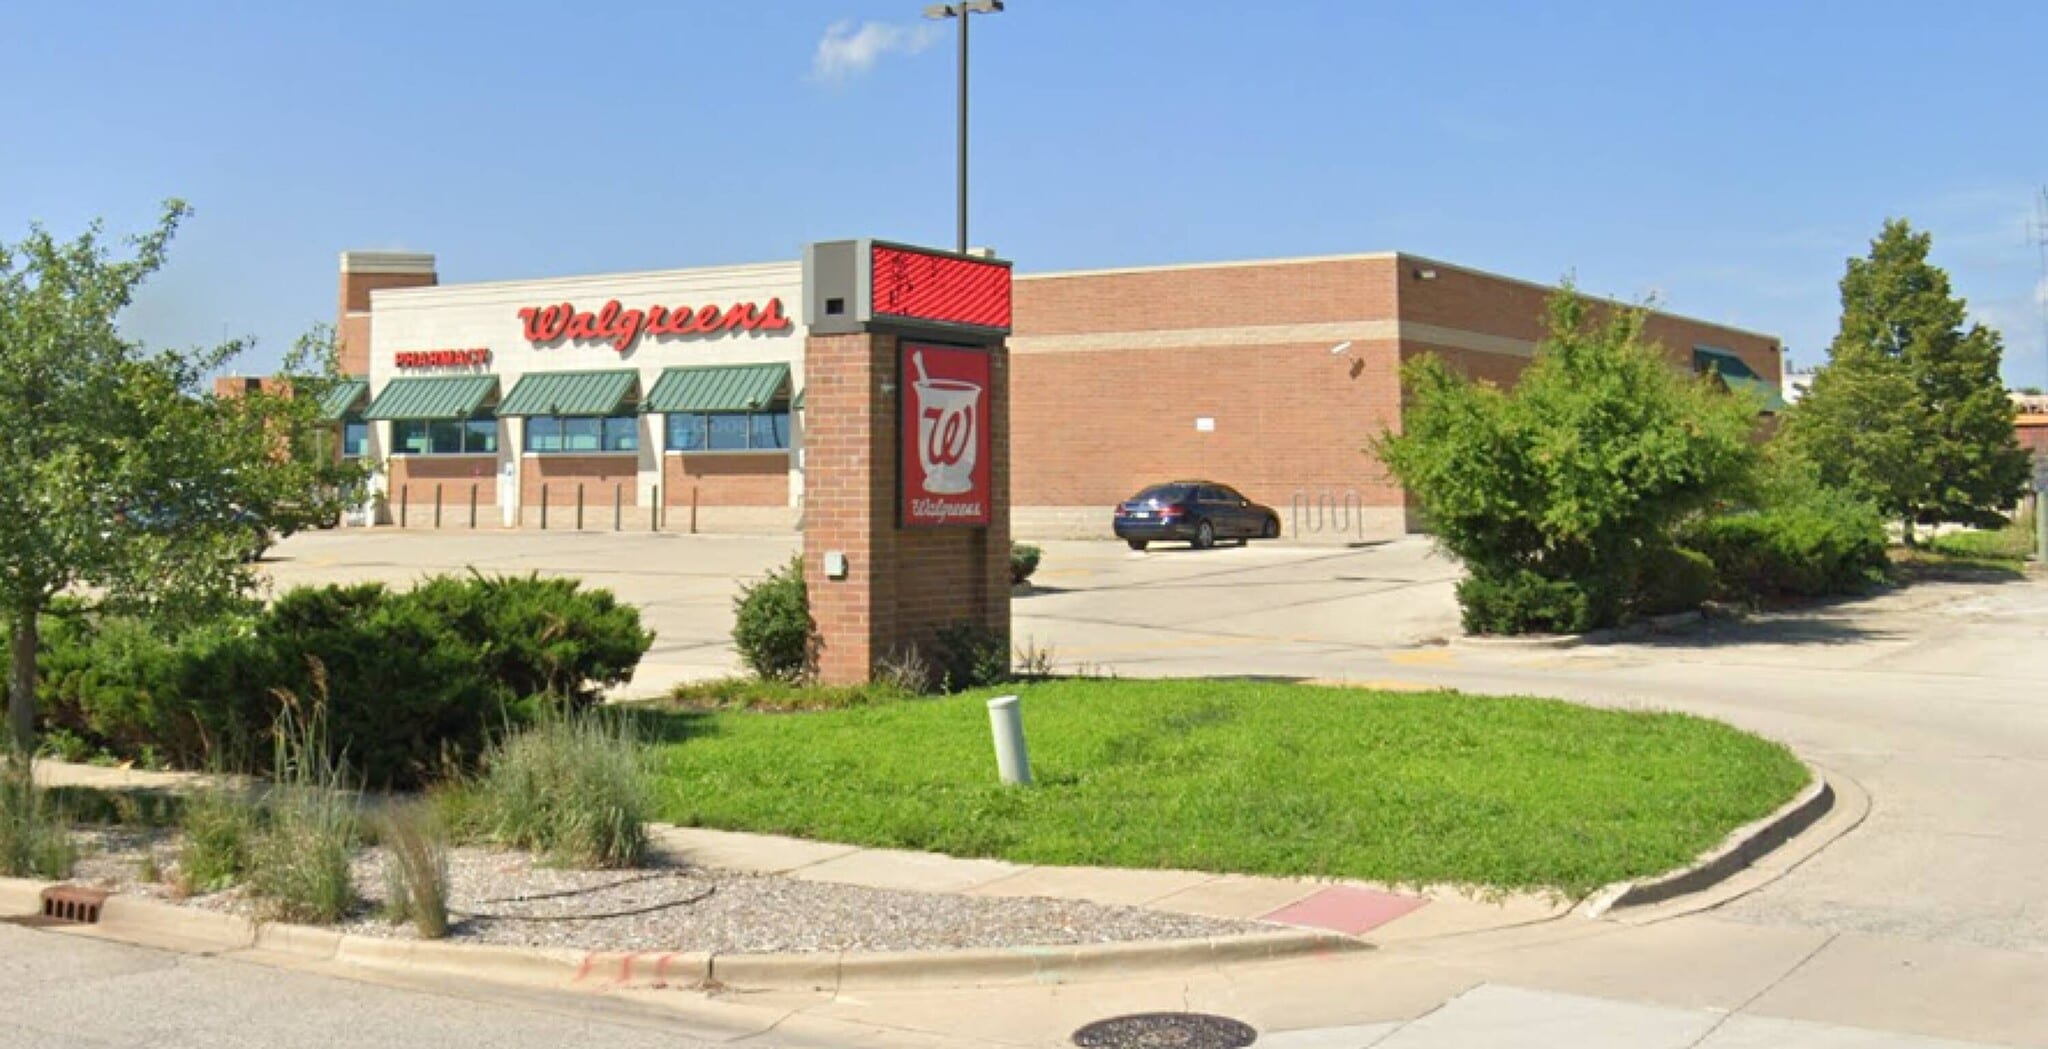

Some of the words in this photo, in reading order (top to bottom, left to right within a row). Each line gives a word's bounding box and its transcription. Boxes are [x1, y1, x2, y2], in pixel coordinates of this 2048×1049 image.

[518, 297, 790, 352] Walgreens
[394, 348, 489, 367] PHARMACY
[924, 403, 972, 466] W
[912, 498, 982, 523] Walgreens
